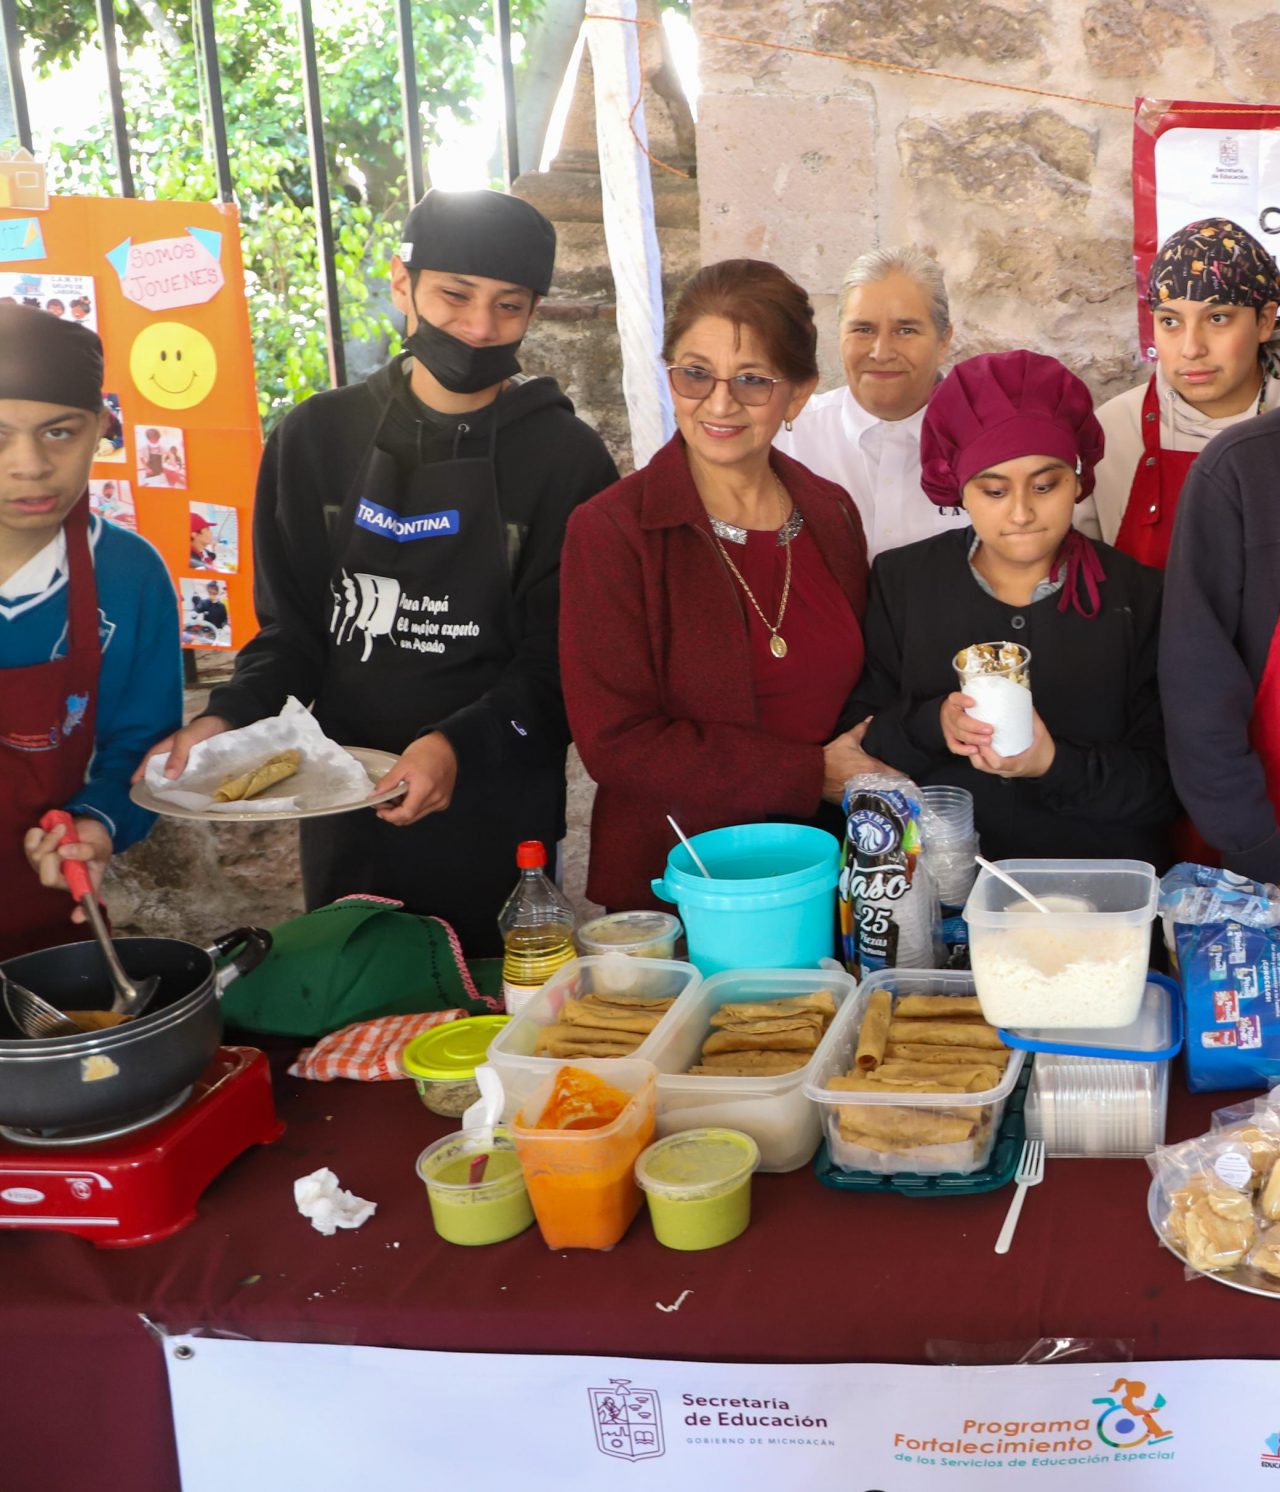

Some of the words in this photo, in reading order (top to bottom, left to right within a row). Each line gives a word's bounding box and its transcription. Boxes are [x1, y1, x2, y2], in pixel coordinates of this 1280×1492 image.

[131, 243, 196, 269] SOMOS
[358, 504, 451, 535] TRAMONTINA
[421, 595, 449, 616] Papá
[411, 619, 440, 637] mejor
[441, 621, 480, 640] experto
[413, 638, 446, 654] Asado
[852, 811, 892, 832] REYMA
[860, 905, 894, 935] 25
[682, 1393, 790, 1410] Secretaría
[684, 1412, 712, 1426] de
[718, 1411, 828, 1428] Educación
[963, 1418, 1090, 1437] Programa
[686, 1437, 745, 1445] GOBIERNO
[768, 1438, 835, 1446] MICHOACÁN
[894, 1433, 1093, 1454] Fortalecimiento
[894, 1453, 913, 1462] de
[917, 1456, 936, 1465] los
[940, 1457, 1004, 1468] Servicios
[1007, 1458, 1027, 1468] de
[1031, 1454, 1110, 1467] Educación
[1114, 1451, 1175, 1463] Especial
